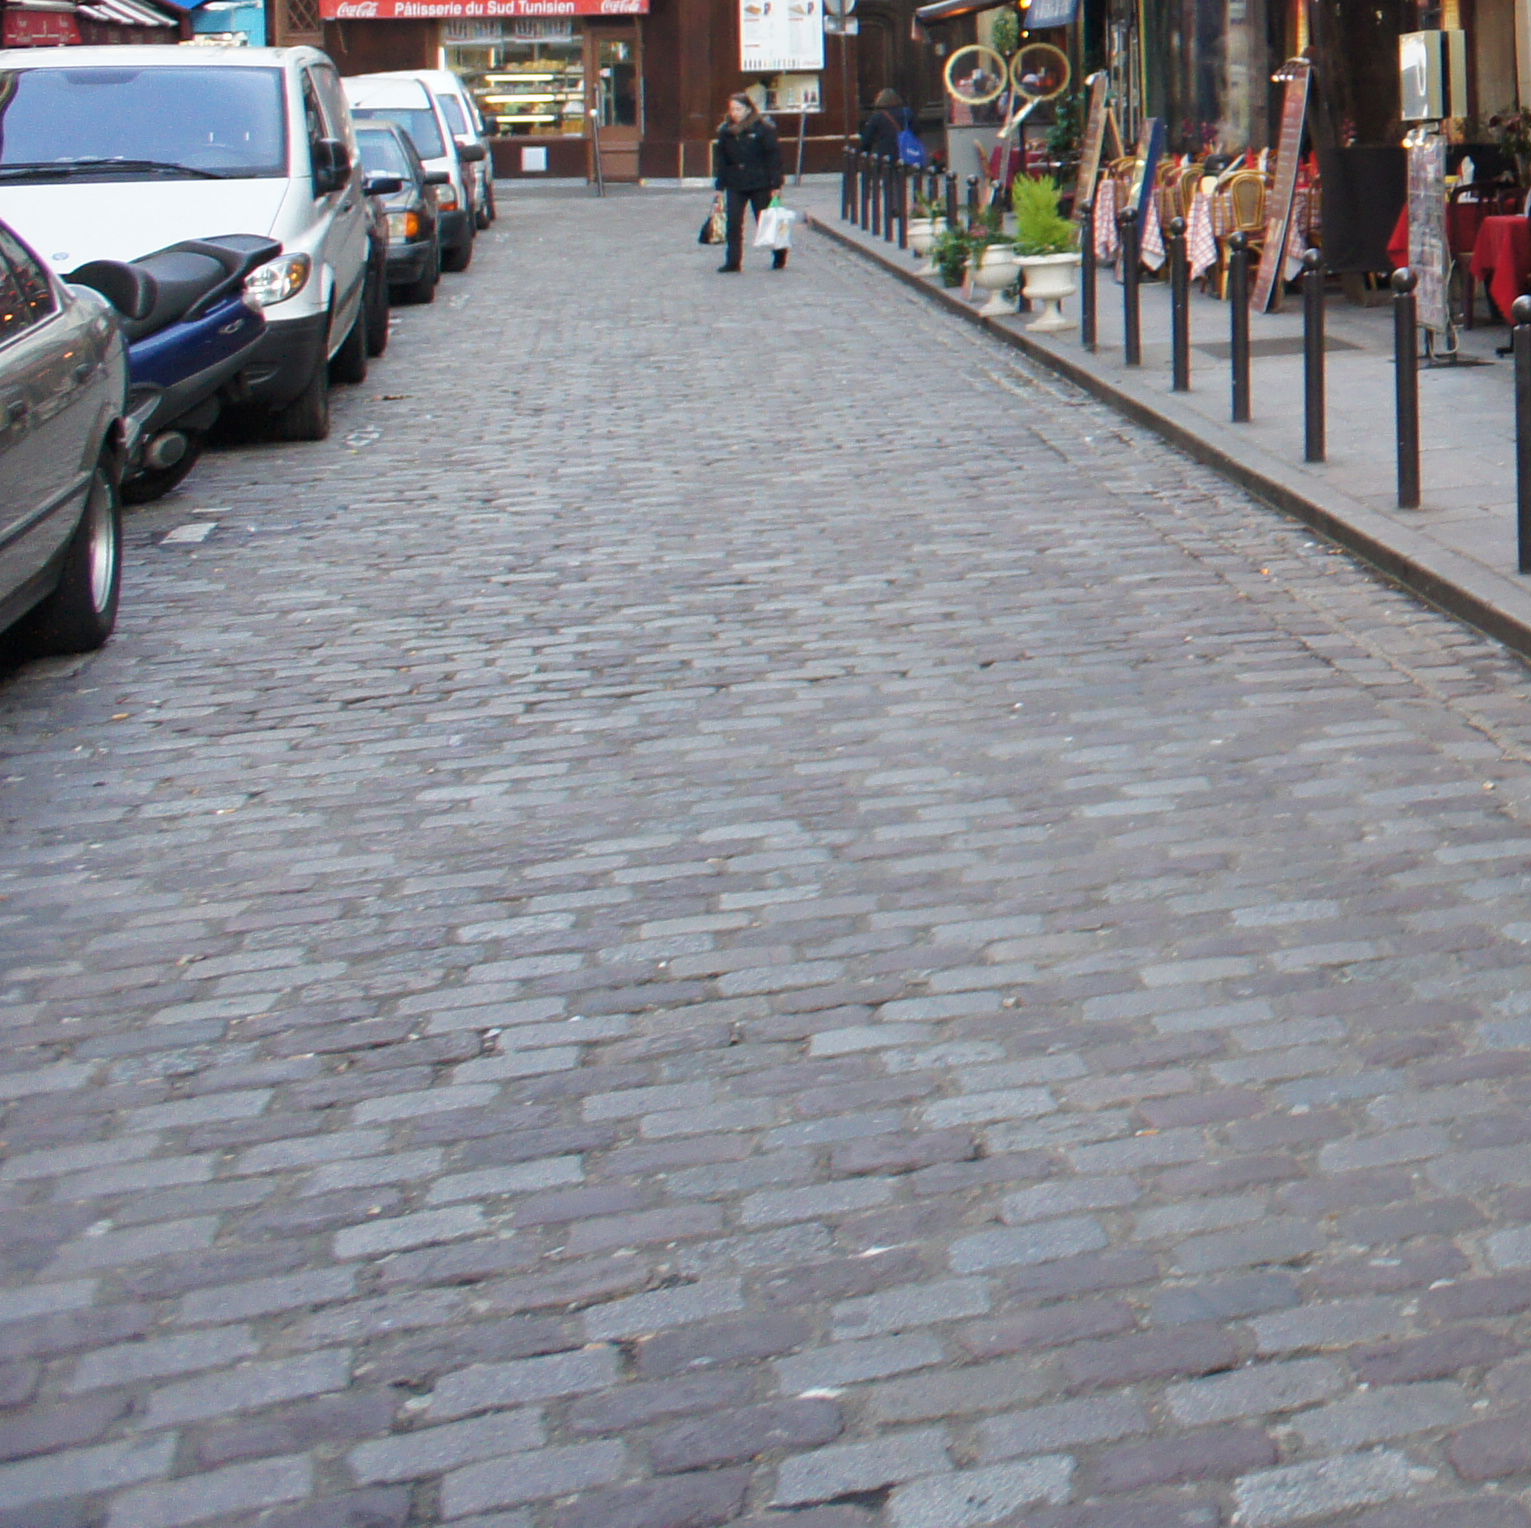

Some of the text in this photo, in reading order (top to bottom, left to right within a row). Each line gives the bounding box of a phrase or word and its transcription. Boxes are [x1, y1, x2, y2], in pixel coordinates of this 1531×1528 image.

[336, 1, 379, 17] Coca-Cola
[394, 0, 463, 16] Pâtisserie
[466, 1, 484, 15] du
[489, 0, 515, 14] Sud
[518, 0, 575, 14] Tunisien
